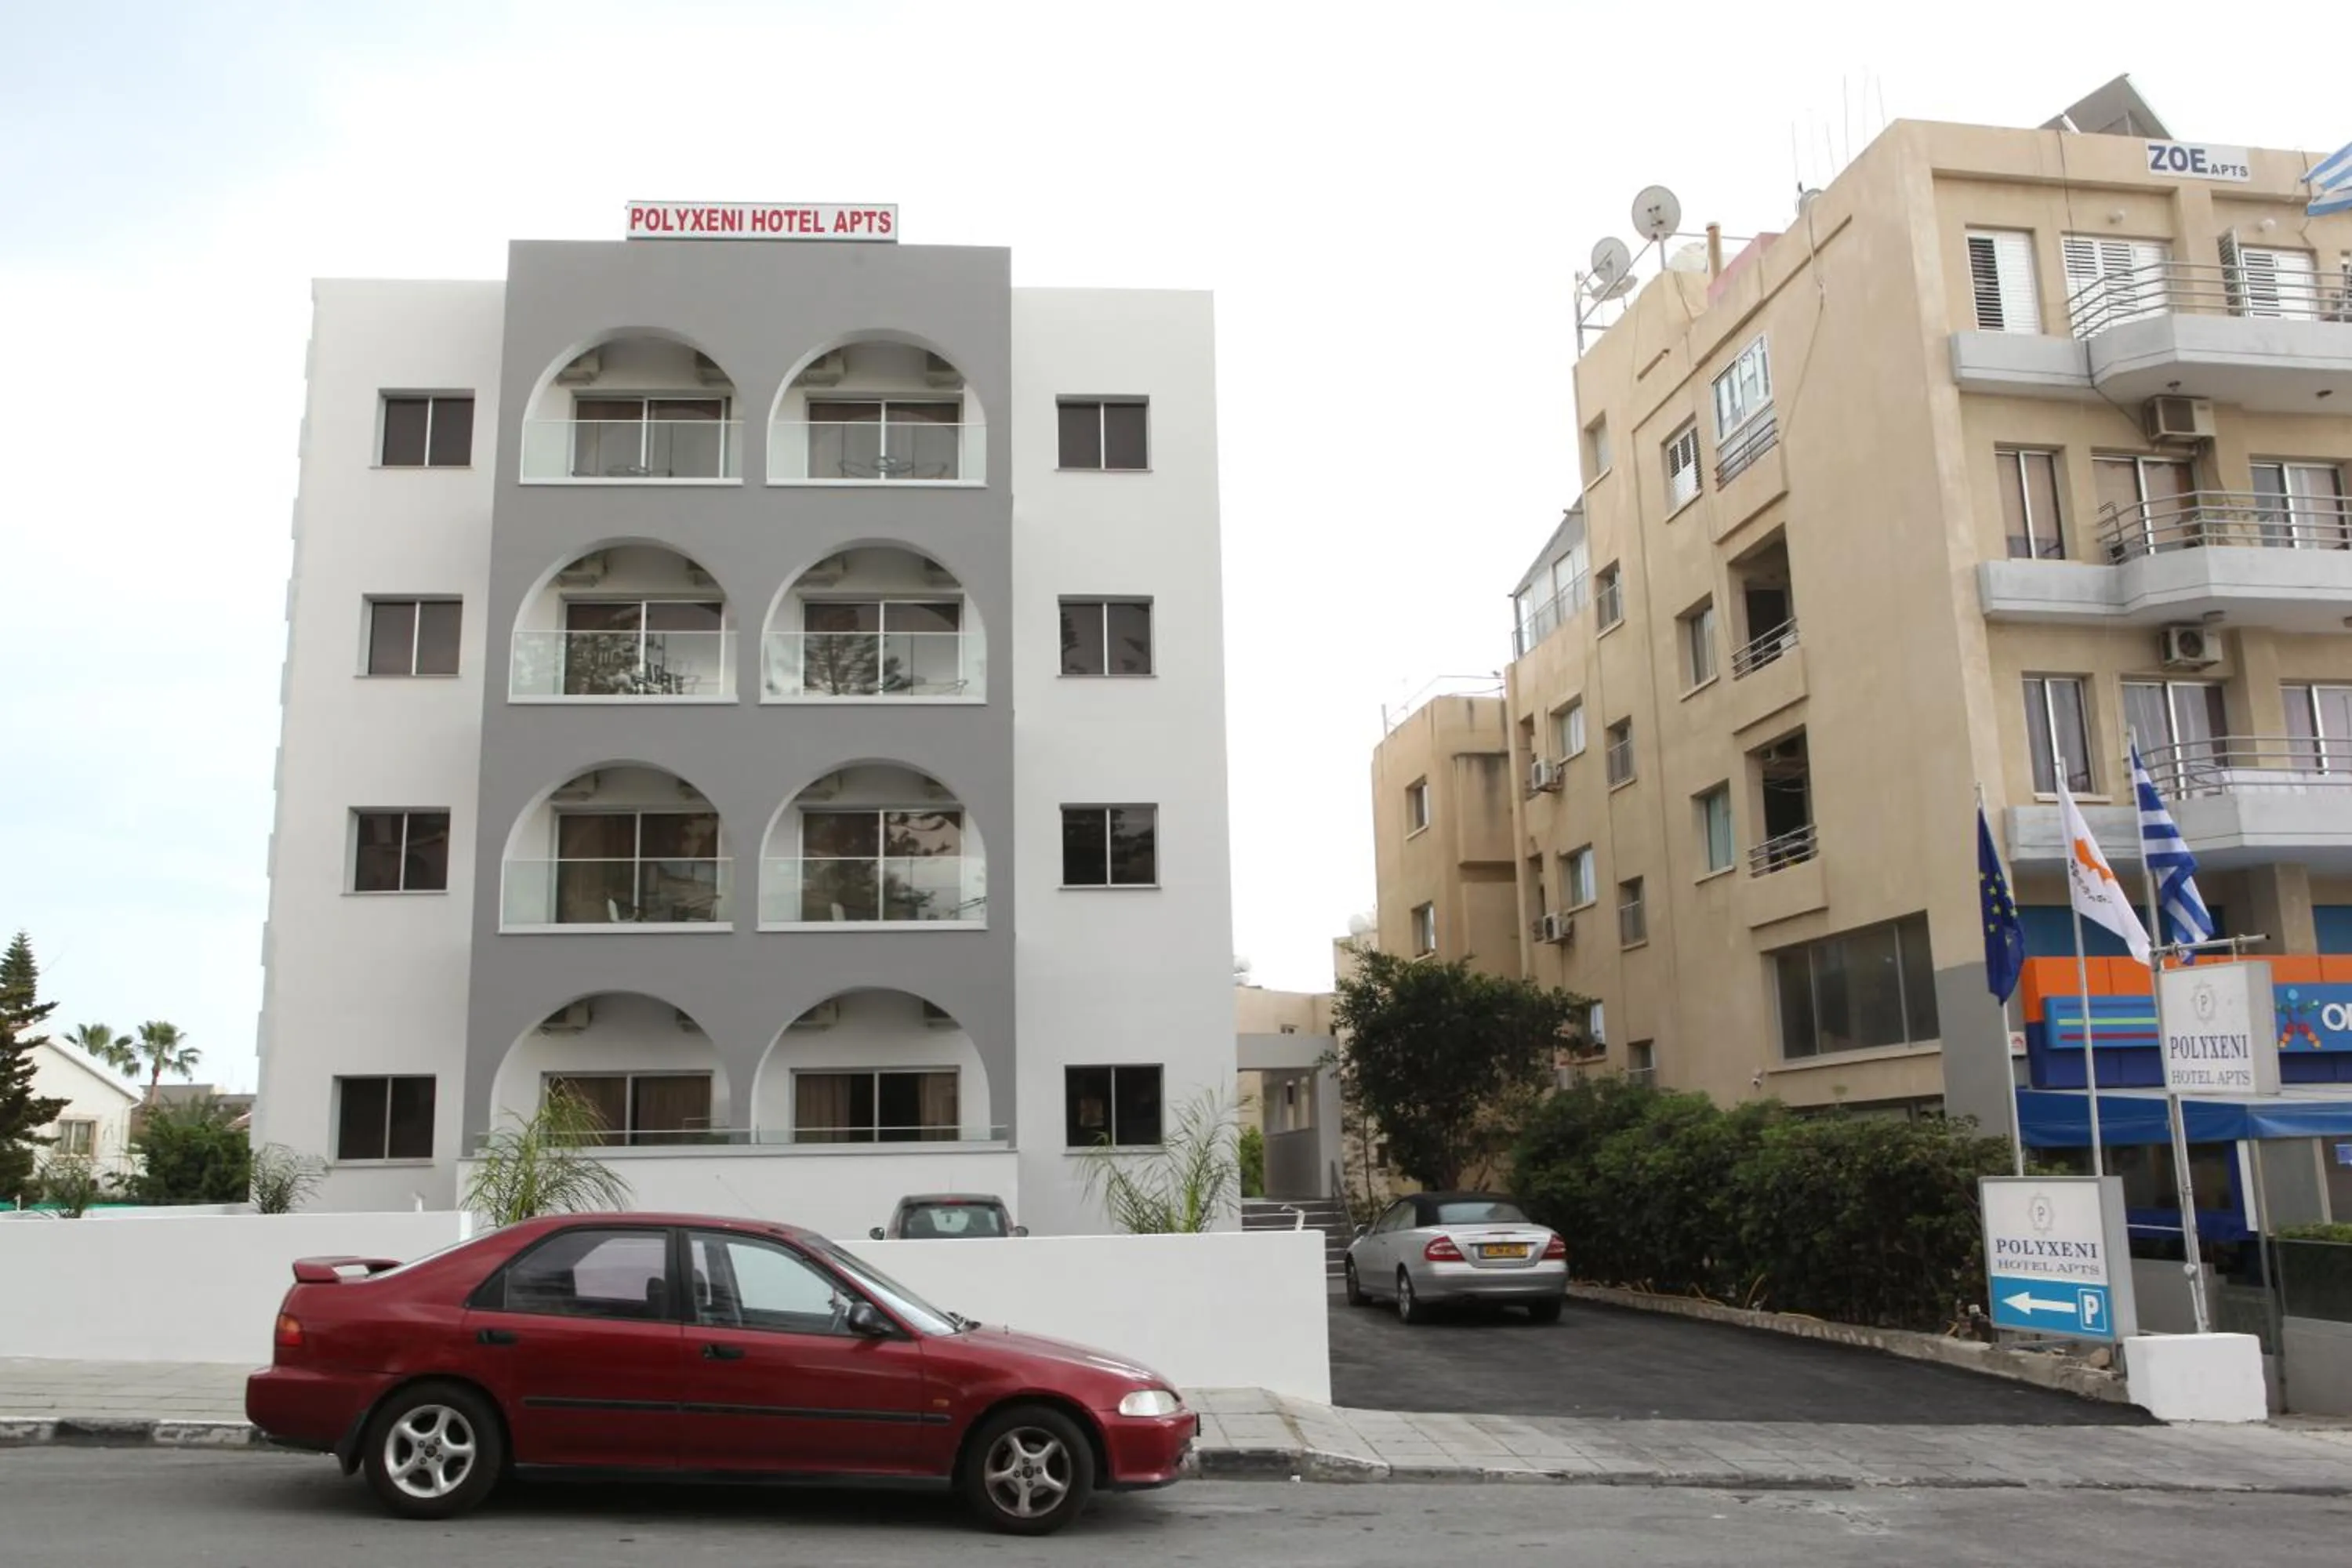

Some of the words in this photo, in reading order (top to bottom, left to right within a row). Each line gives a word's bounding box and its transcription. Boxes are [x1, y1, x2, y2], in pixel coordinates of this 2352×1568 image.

[2147, 144, 2209, 174] ZOE
[2210, 163, 2249, 177] APTS
[630, 208, 744, 232] POLYXENI
[751, 209, 825, 234] HOTEL
[833, 210, 891, 234] APTS
[2200, 994, 2209, 1012] P
[2169, 1034, 2249, 1059] POLYXENI
[2171, 1069, 2215, 1085] HOTEL
[2217, 1069, 2252, 1087] APTS
[1995, 1237, 2098, 1259] POLYXENI
[1997, 1258, 2053, 1273] HOTEL
[2056, 1261, 2100, 1276] APTS
[2083, 1294, 2099, 1325] P
